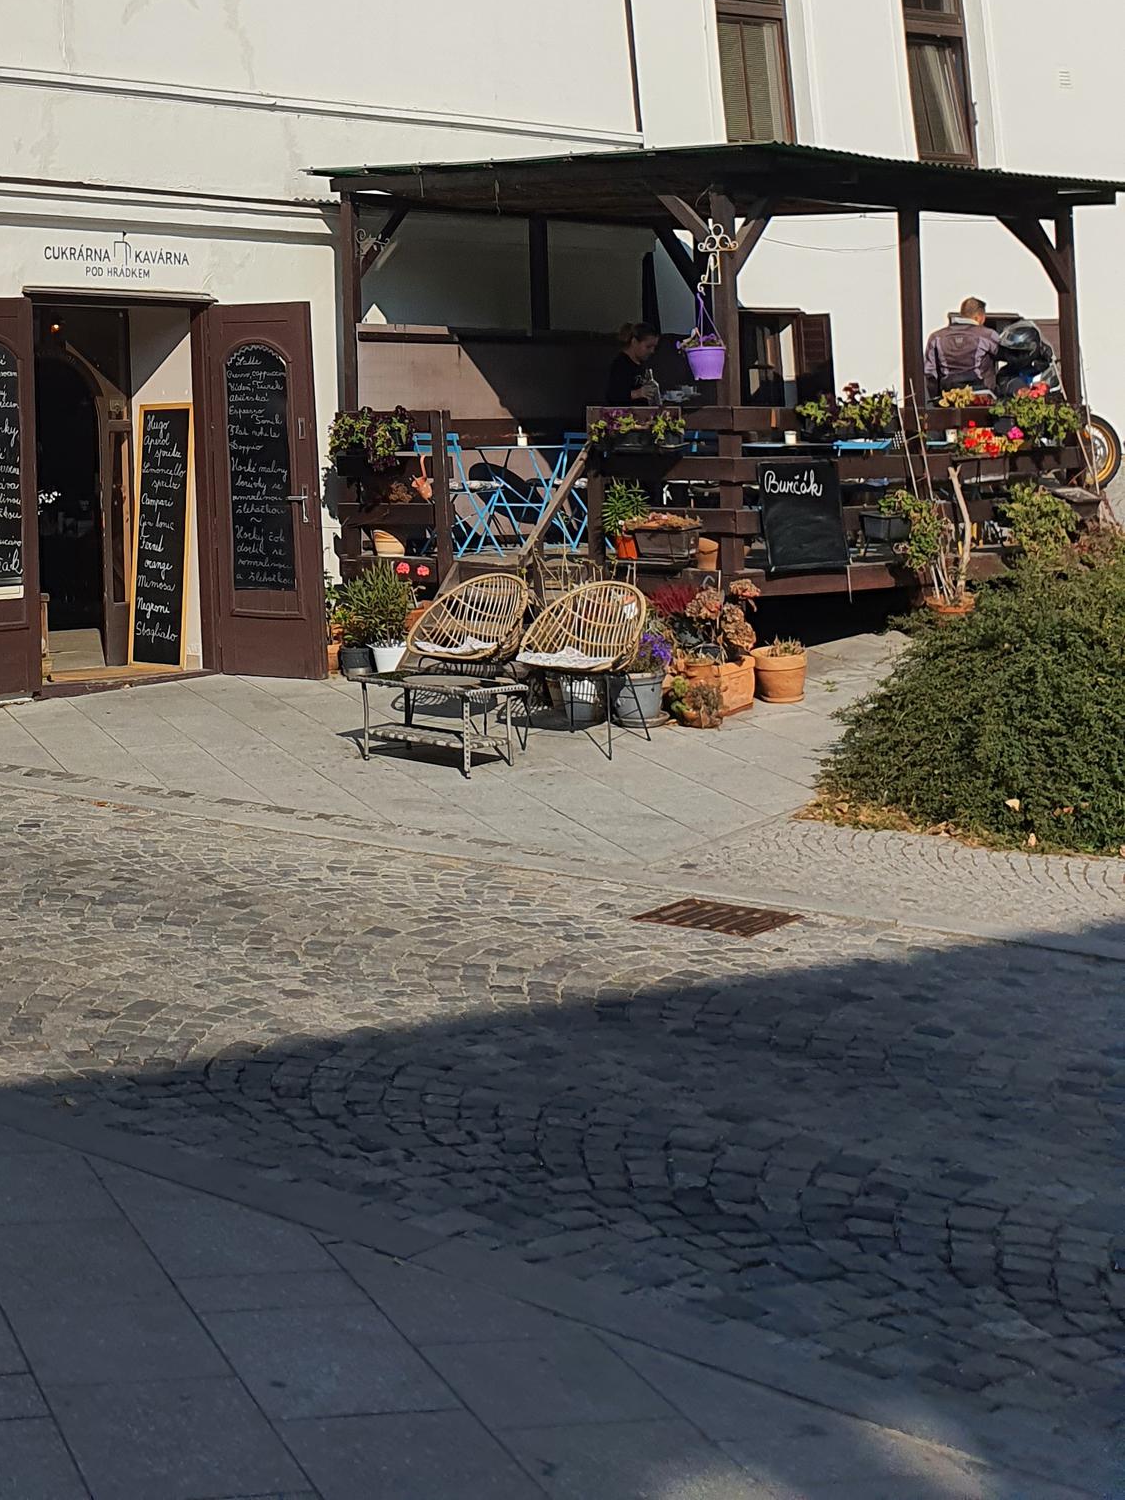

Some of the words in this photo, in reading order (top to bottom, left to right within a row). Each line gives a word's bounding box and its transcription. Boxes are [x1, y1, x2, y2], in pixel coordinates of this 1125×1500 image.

[44, 244, 111, 262] CUKRÁRNA
[134, 248, 189, 265] KAVÁRNA
[85, 266, 103, 277] POD
[107, 265, 150, 278] HRÁDKEM
[235, 356, 262, 366] Latte
[147, 414, 170, 438] Hugo
[227, 425, 249, 436] Flat
[144, 433, 170, 453] Aperol
[142, 461, 186, 477] Limoncello
[231, 456, 256, 473] Horké
[764, 469, 823, 497] Burčák
[141, 492, 174, 512] Campari
[144, 559, 173, 580] orange
[137, 574, 176, 592] Mimosa
[137, 597, 171, 619] Negroni
[135, 621, 178, 643] Sbagliato
